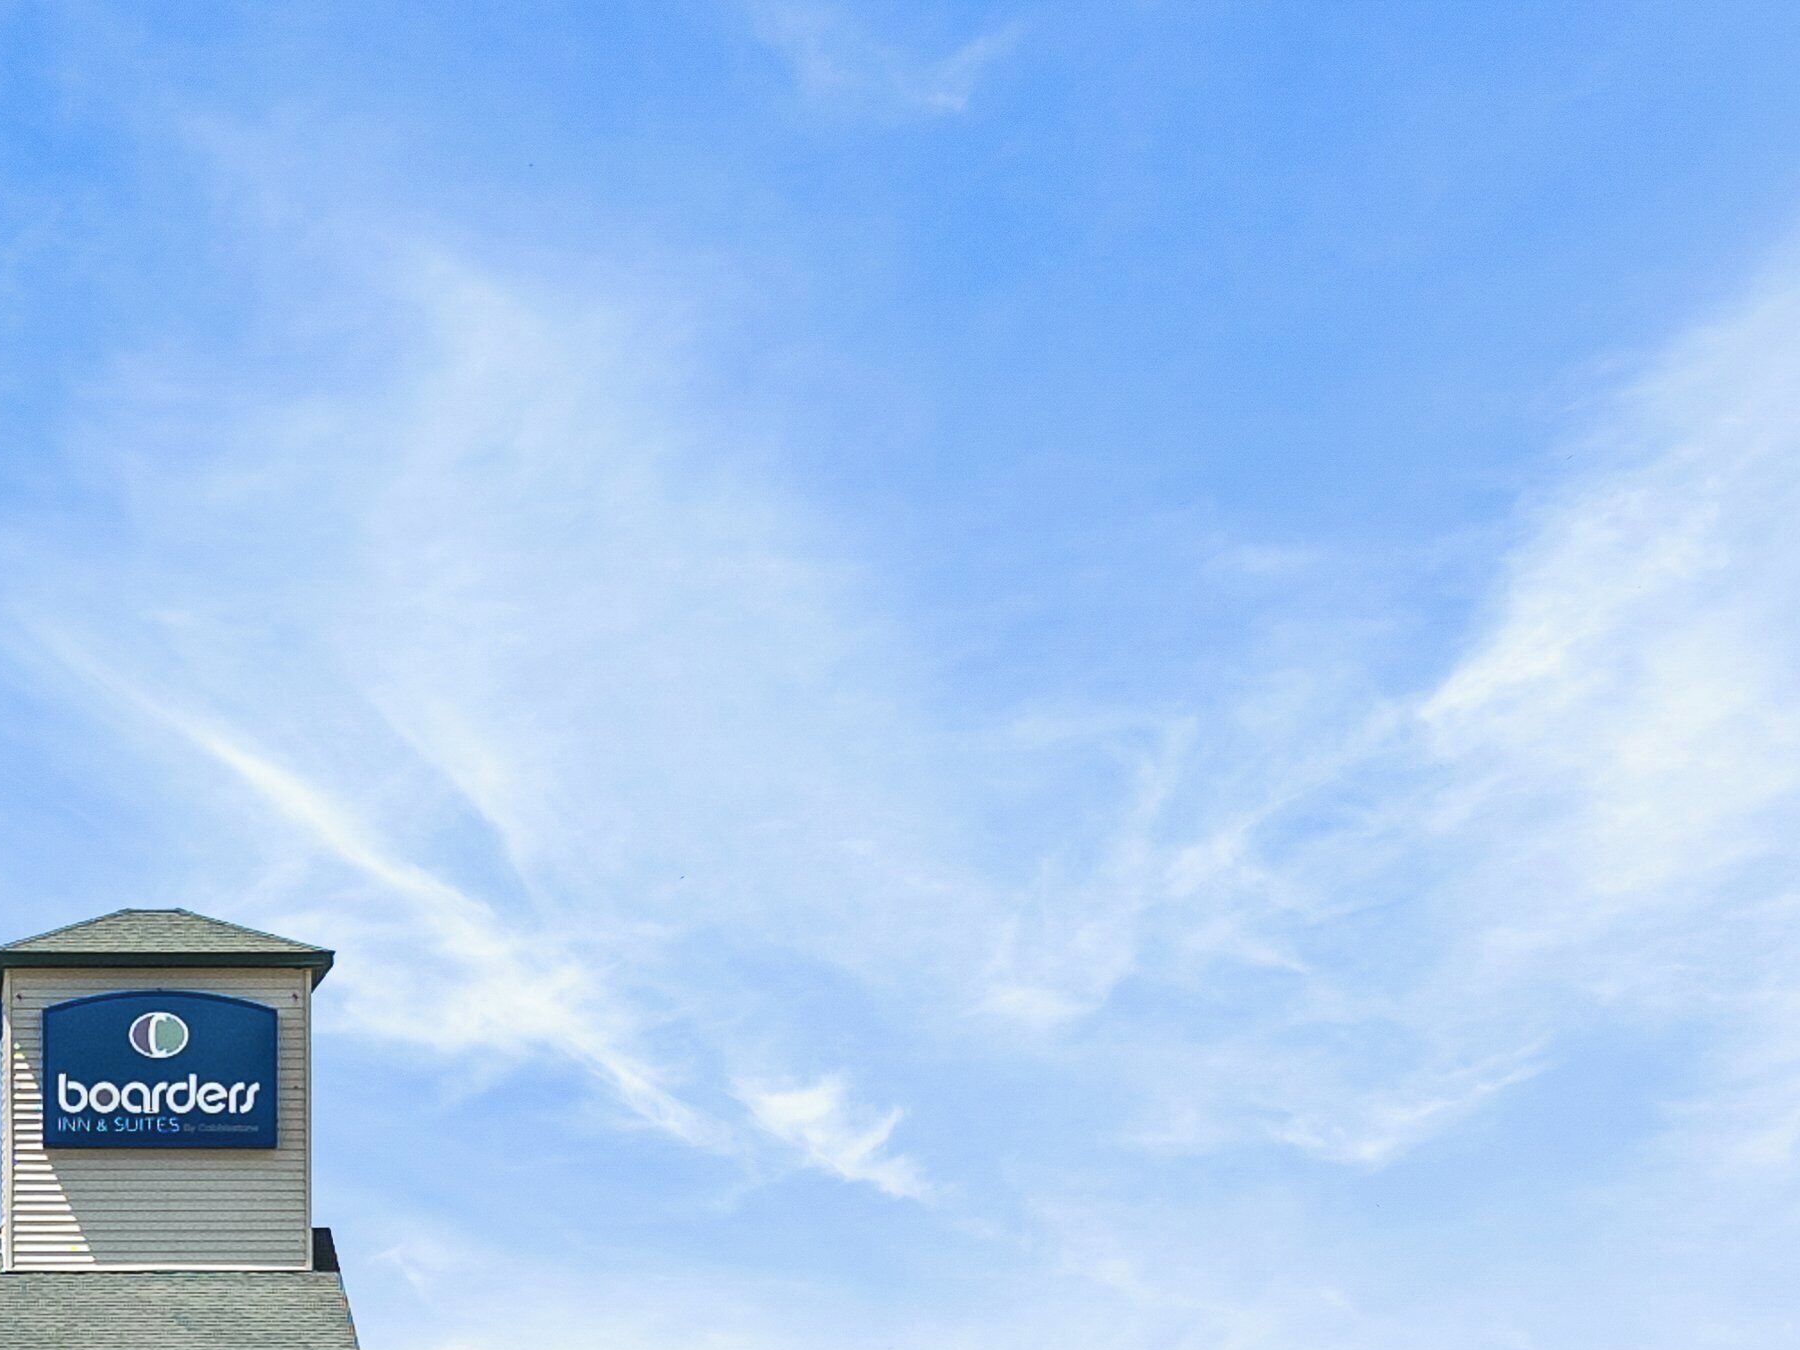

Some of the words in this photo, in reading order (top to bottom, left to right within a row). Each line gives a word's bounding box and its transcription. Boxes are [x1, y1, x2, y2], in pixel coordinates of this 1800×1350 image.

[58, 1073, 260, 1114] boarders
[58, 1117, 91, 1132] INN
[96, 1117, 108, 1132] &
[114, 1117, 180, 1132] SUITES
